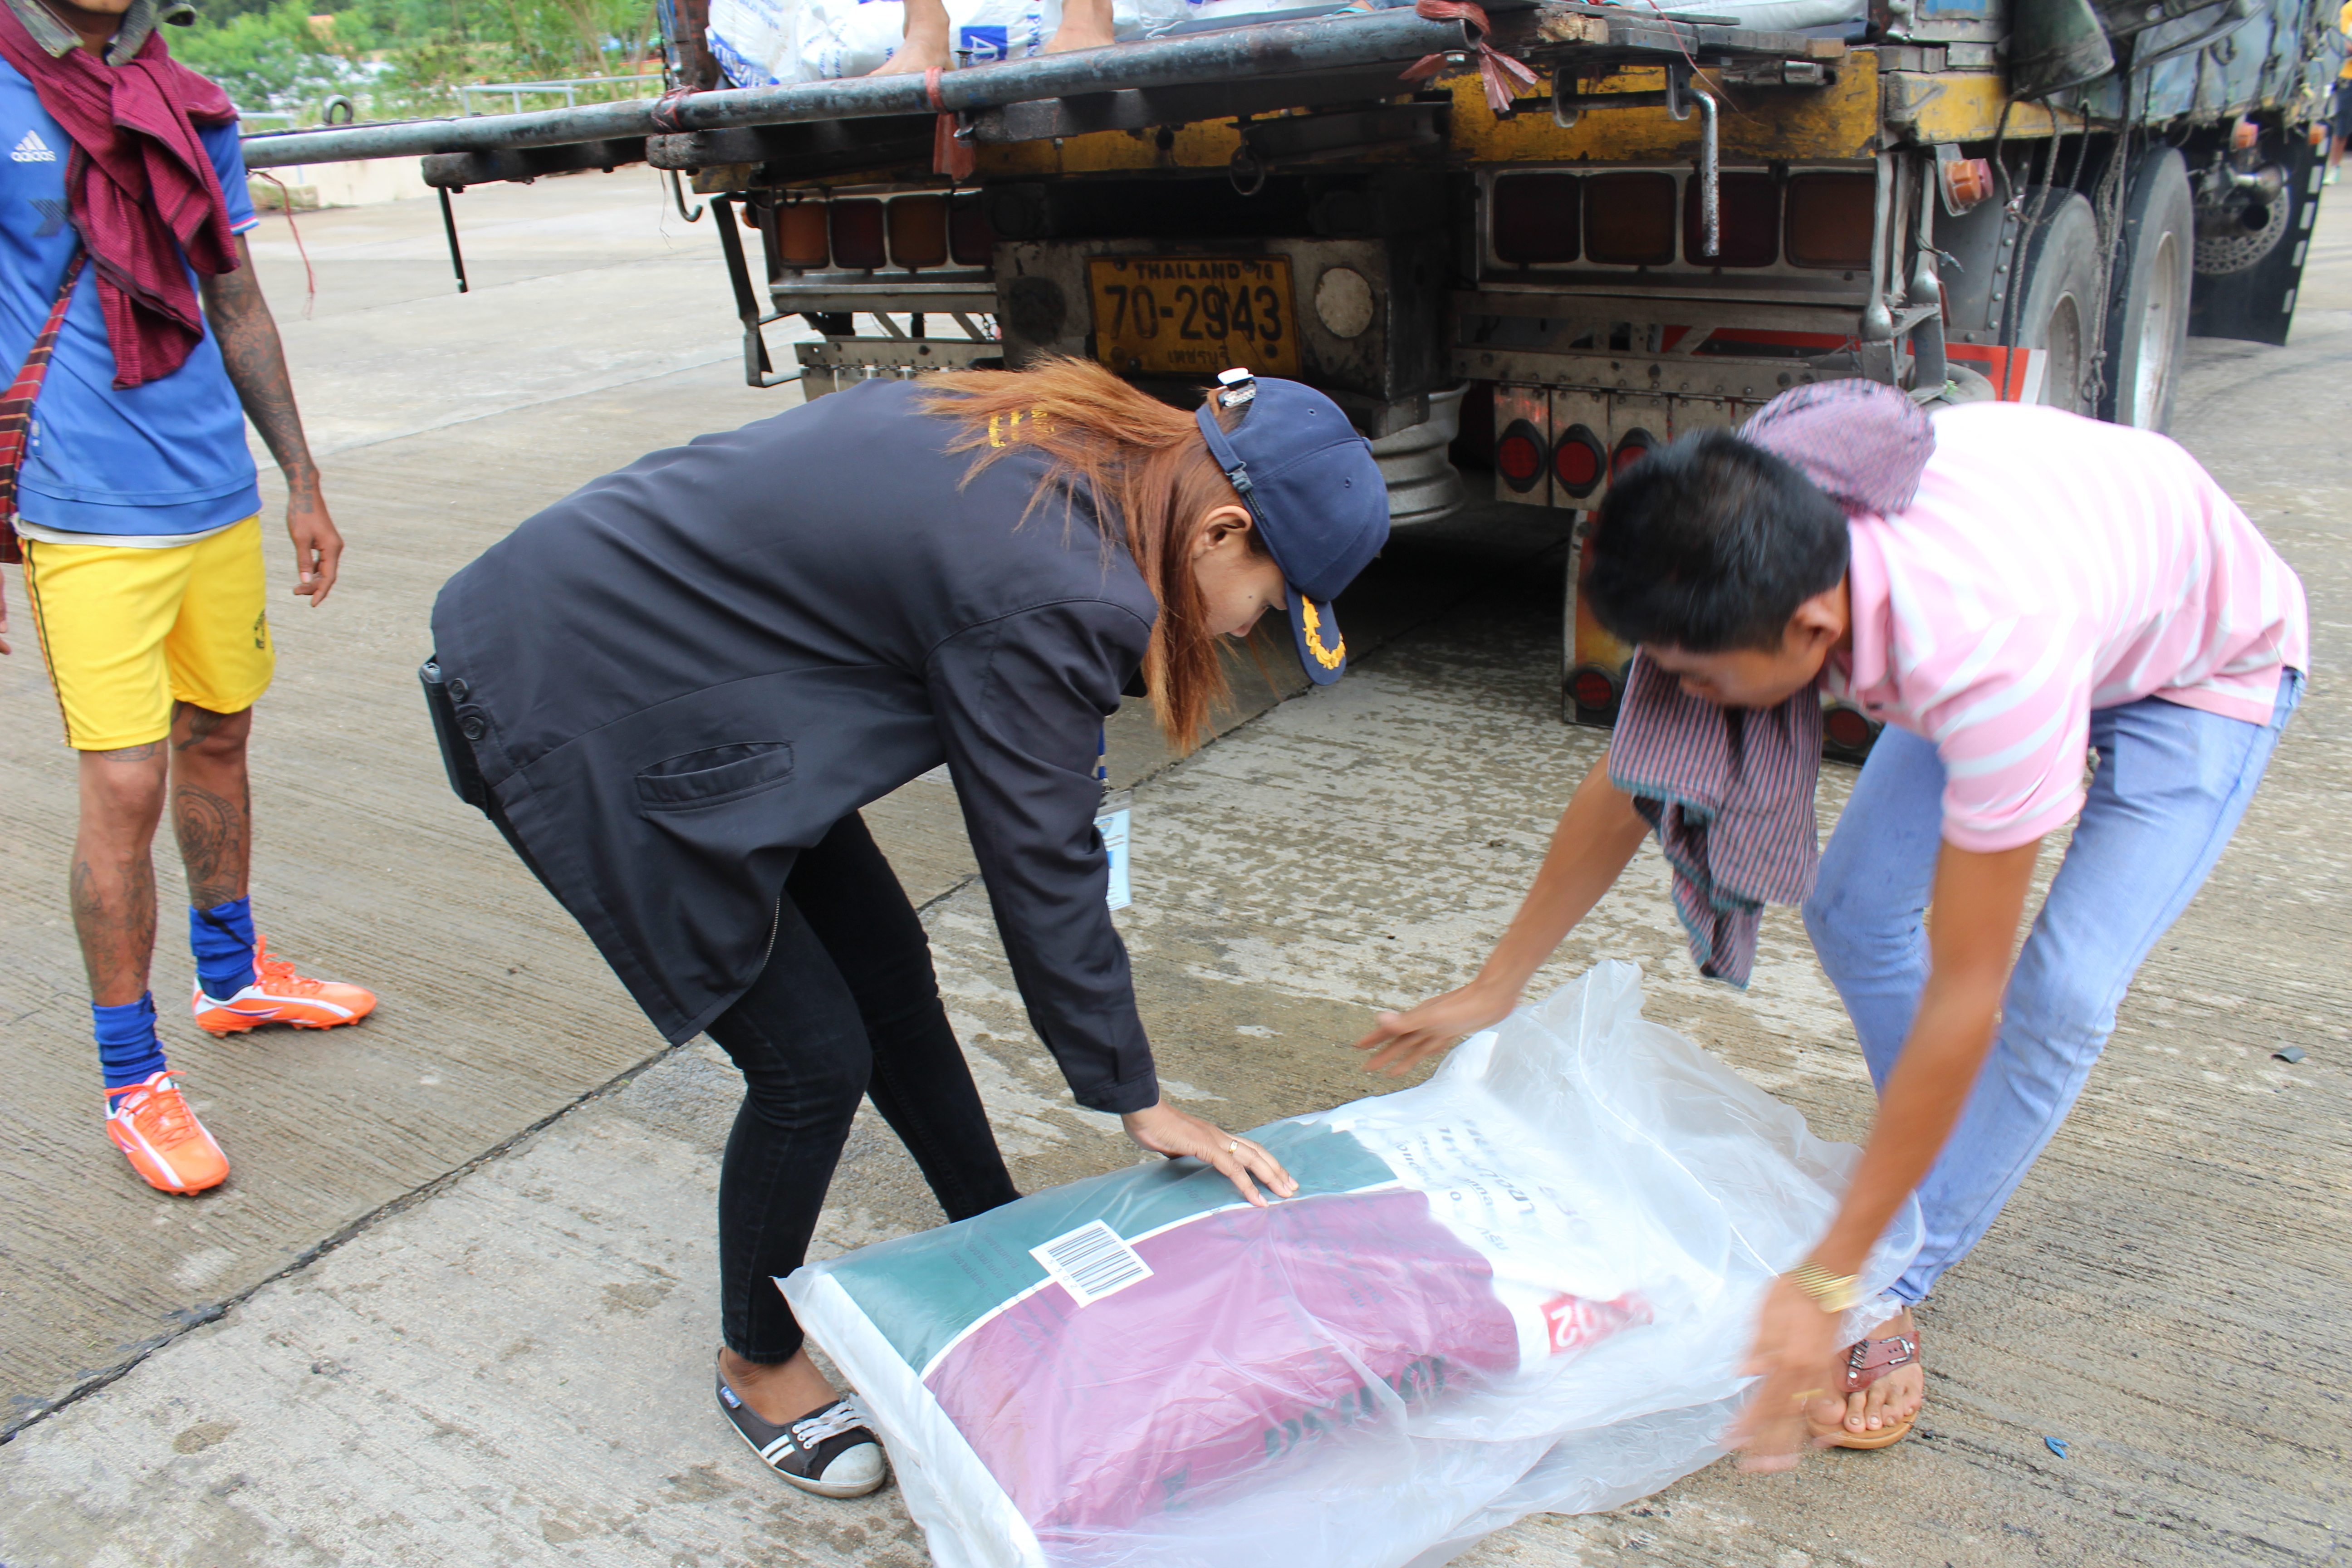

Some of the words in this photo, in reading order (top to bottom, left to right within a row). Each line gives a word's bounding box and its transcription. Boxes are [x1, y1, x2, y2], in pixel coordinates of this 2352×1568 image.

[11, 150, 56, 162] adidas
[1136, 262, 1240, 279] THAILAND
[1104, 284, 1282, 341] 70-2943
[1048, 1259, 1078, 1289] 5302
